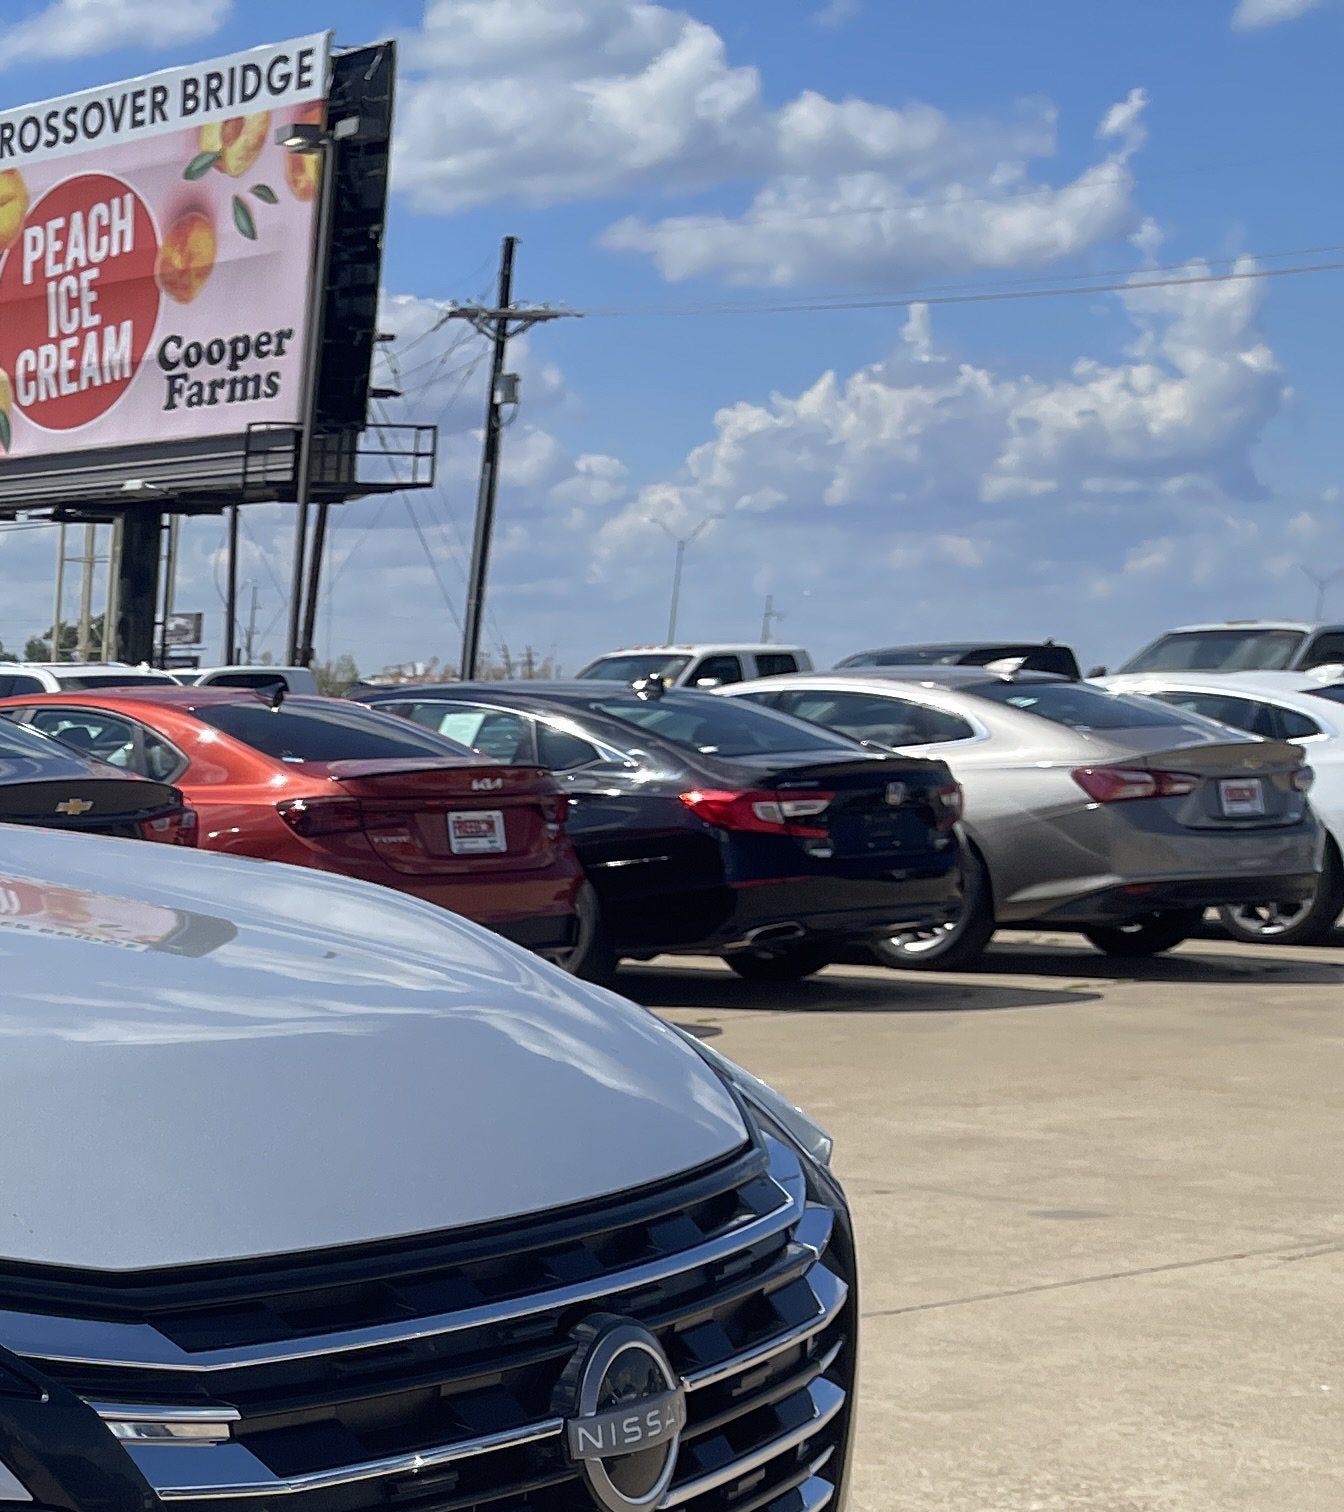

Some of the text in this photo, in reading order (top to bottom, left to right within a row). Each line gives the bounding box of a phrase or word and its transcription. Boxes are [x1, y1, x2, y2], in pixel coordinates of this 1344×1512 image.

[179, 48, 316, 118] BRIDGE
[22, 192, 135, 286] PEACH
[47, 266, 102, 339] ICE
[14, 319, 134, 408] CREAM
[157, 327, 294, 372] Cooper
[163, 370, 282, 411] Farms
[471, 777, 503, 791] KIA
